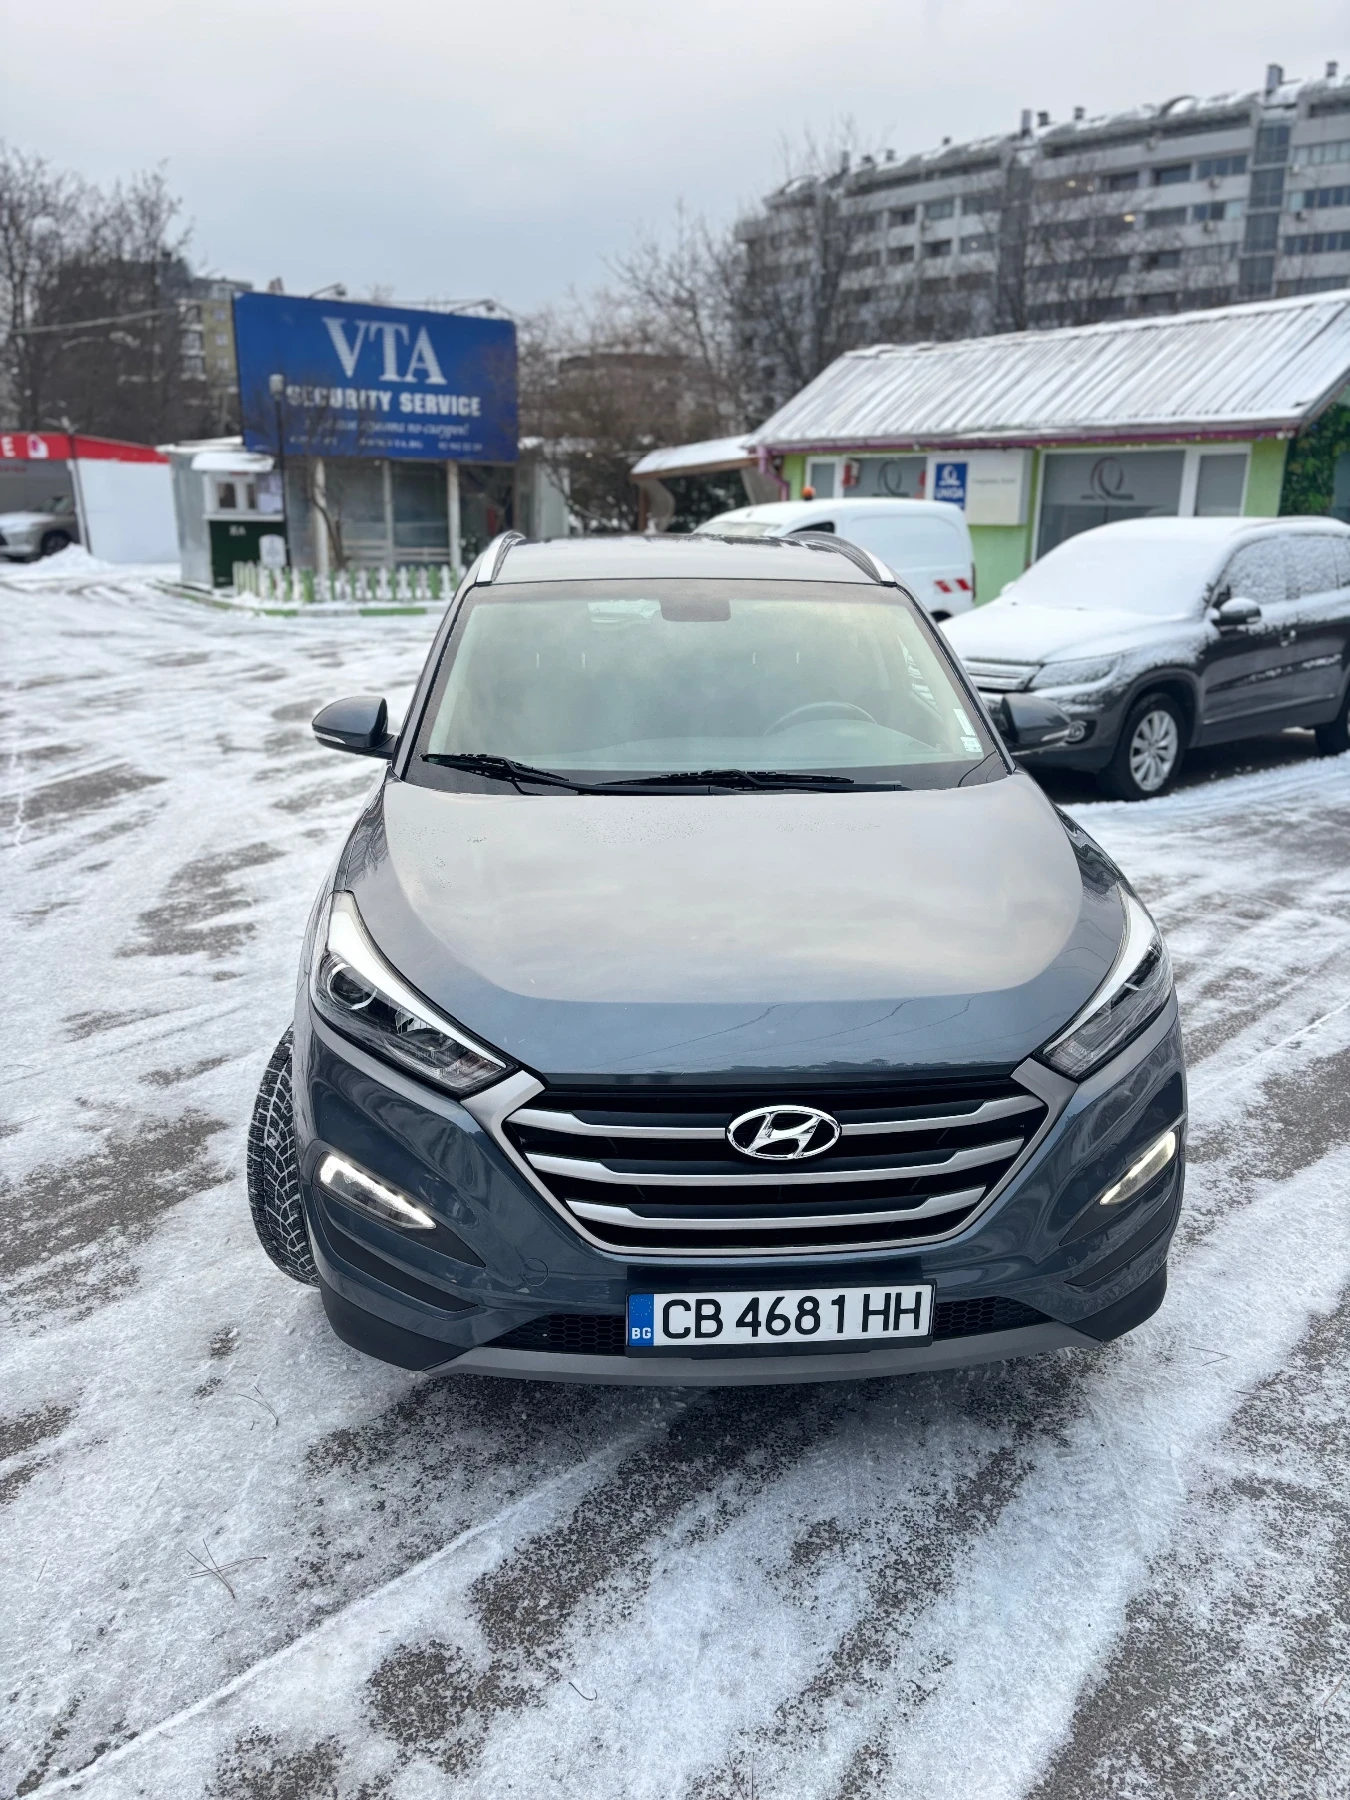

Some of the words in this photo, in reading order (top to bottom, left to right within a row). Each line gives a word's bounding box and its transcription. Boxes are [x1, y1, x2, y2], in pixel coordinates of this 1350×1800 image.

[322, 316, 448, 385] VTA
[286, 384, 393, 413] SECURITY
[399, 392, 482, 418] SERVICE
[631, 1327, 652, 1339] BG
[662, 1299, 724, 1339] CB
[735, 1295, 845, 1338] 4681
[861, 1291, 922, 1332] HH
